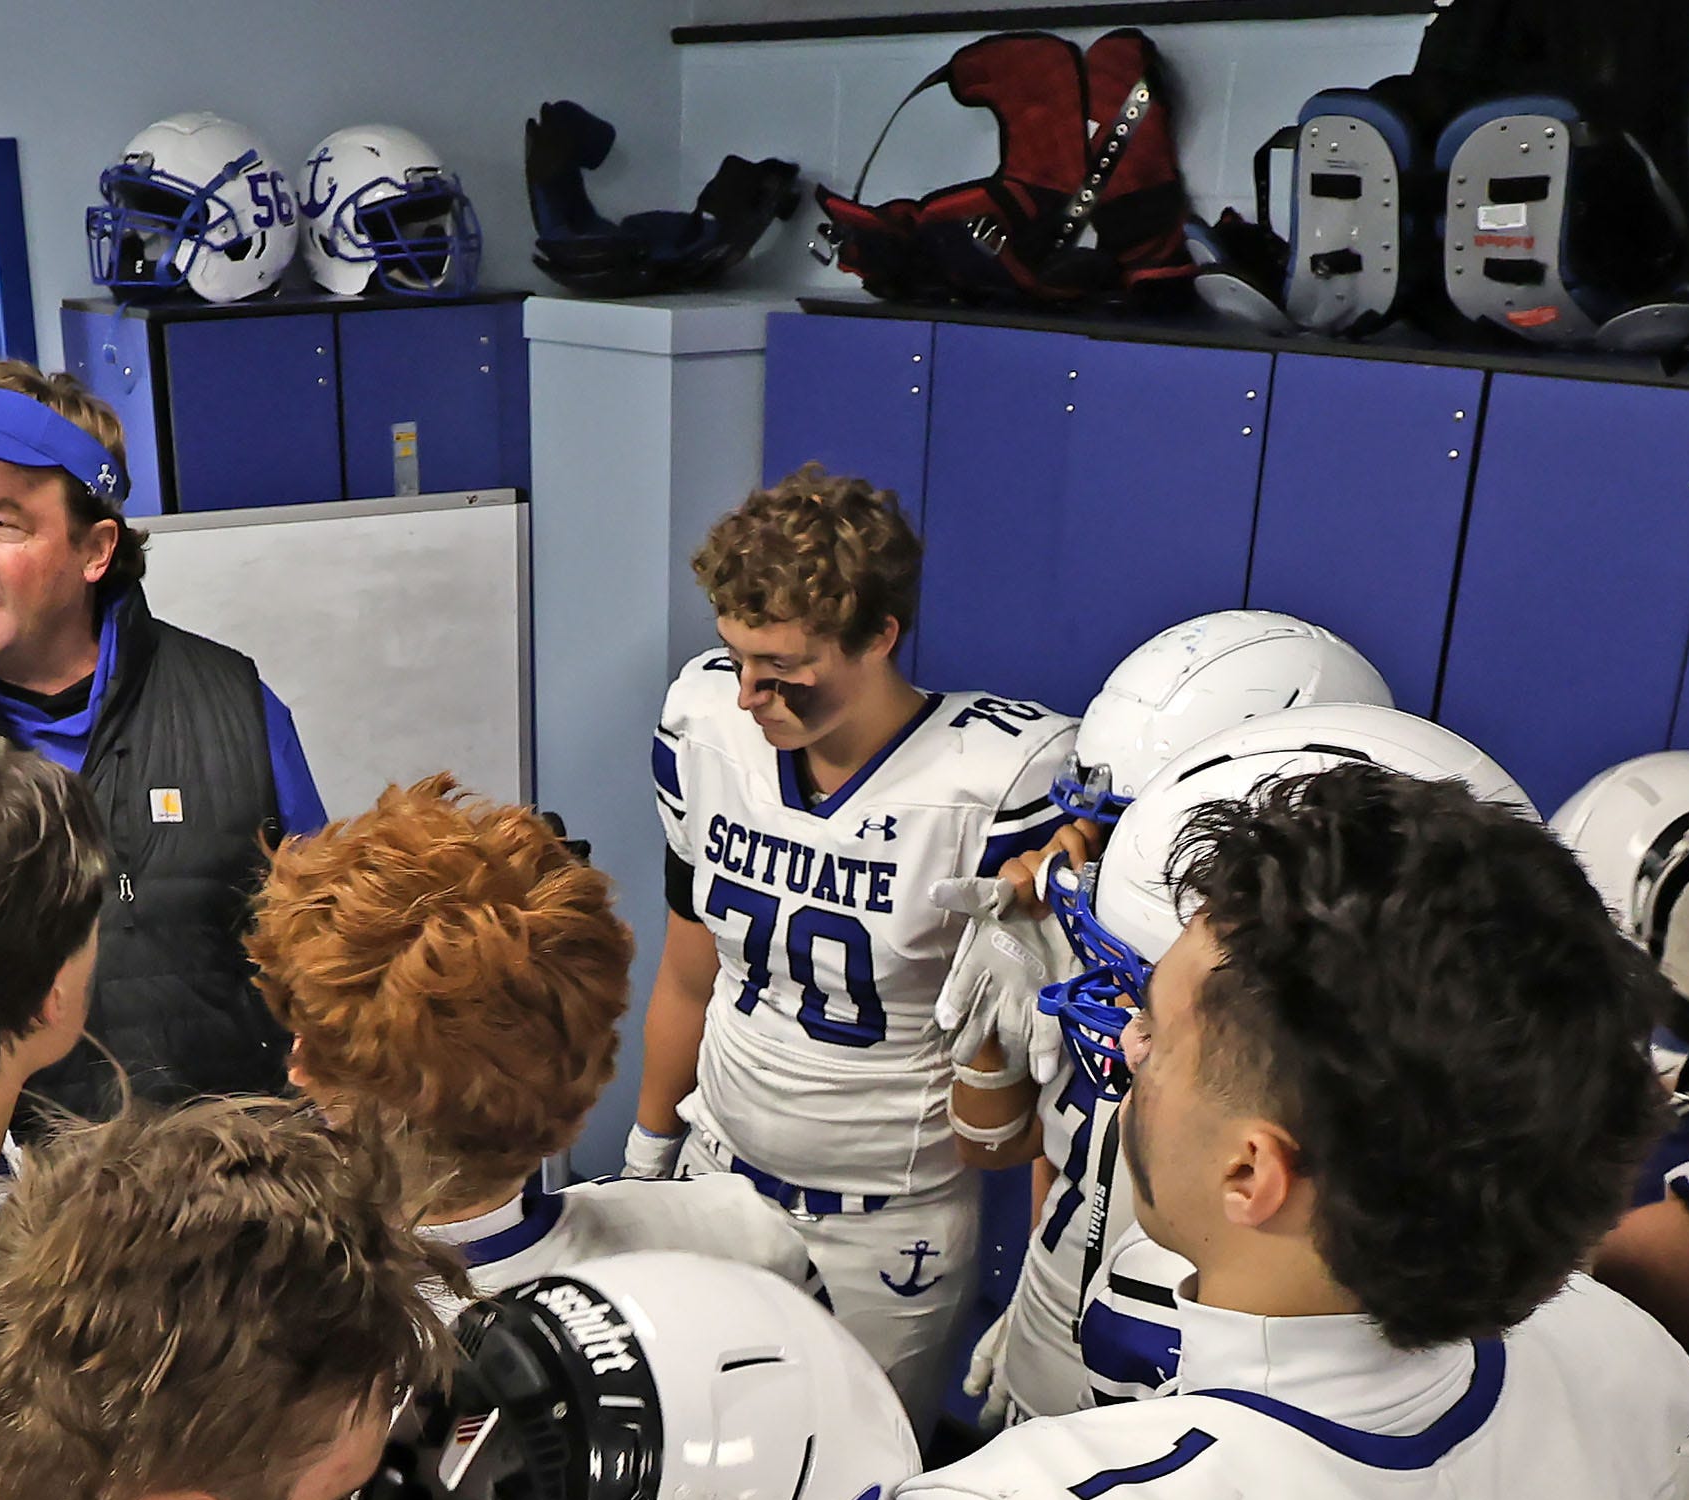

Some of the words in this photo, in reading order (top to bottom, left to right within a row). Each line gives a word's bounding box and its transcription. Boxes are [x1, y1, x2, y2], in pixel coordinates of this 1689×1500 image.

[247, 168, 296, 228] 56
[949, 696, 1049, 738] 70
[705, 813, 898, 914] SCITUATE
[704, 875, 887, 1049] 70
[534, 1283, 639, 1376] schutt
